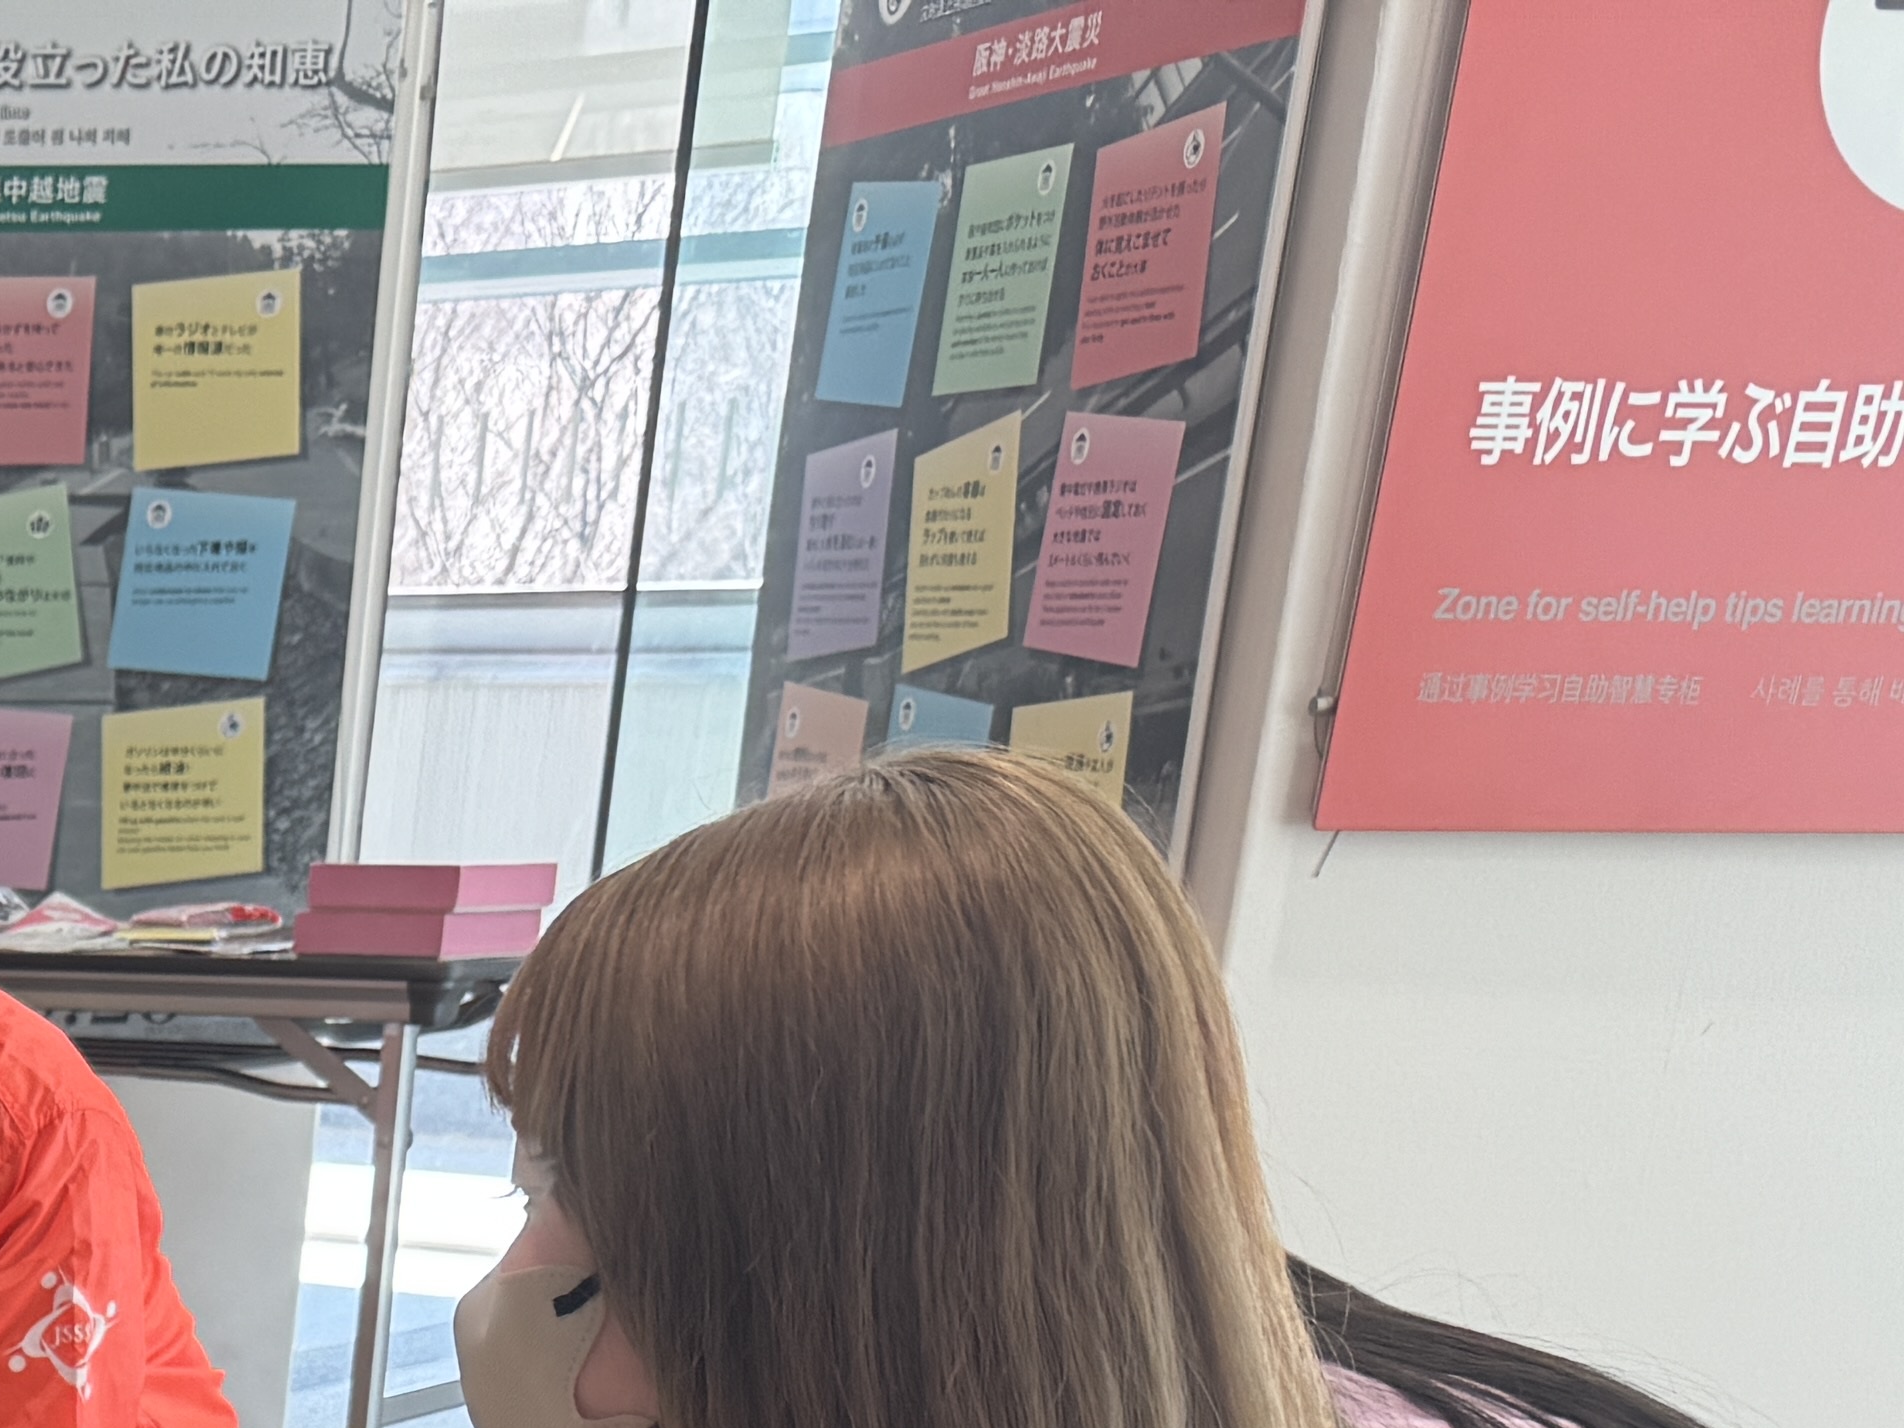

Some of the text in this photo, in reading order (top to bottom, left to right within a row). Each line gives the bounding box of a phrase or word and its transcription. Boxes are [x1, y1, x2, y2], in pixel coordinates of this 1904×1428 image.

[972, 10, 1103, 78] 阪神・淡路大震災
[30, 210, 102, 226] Earthquake
[1467, 375, 1904, 470] 事例に学ぶ自助
[1432, 587, 1904, 632] Zone for self-help tips learnin
[1417, 671, 1702, 707] 通过事例学习自助智慧专柜
[1750, 673, 1825, 707] 사례를
[1833, 674, 1885, 708] 통해
